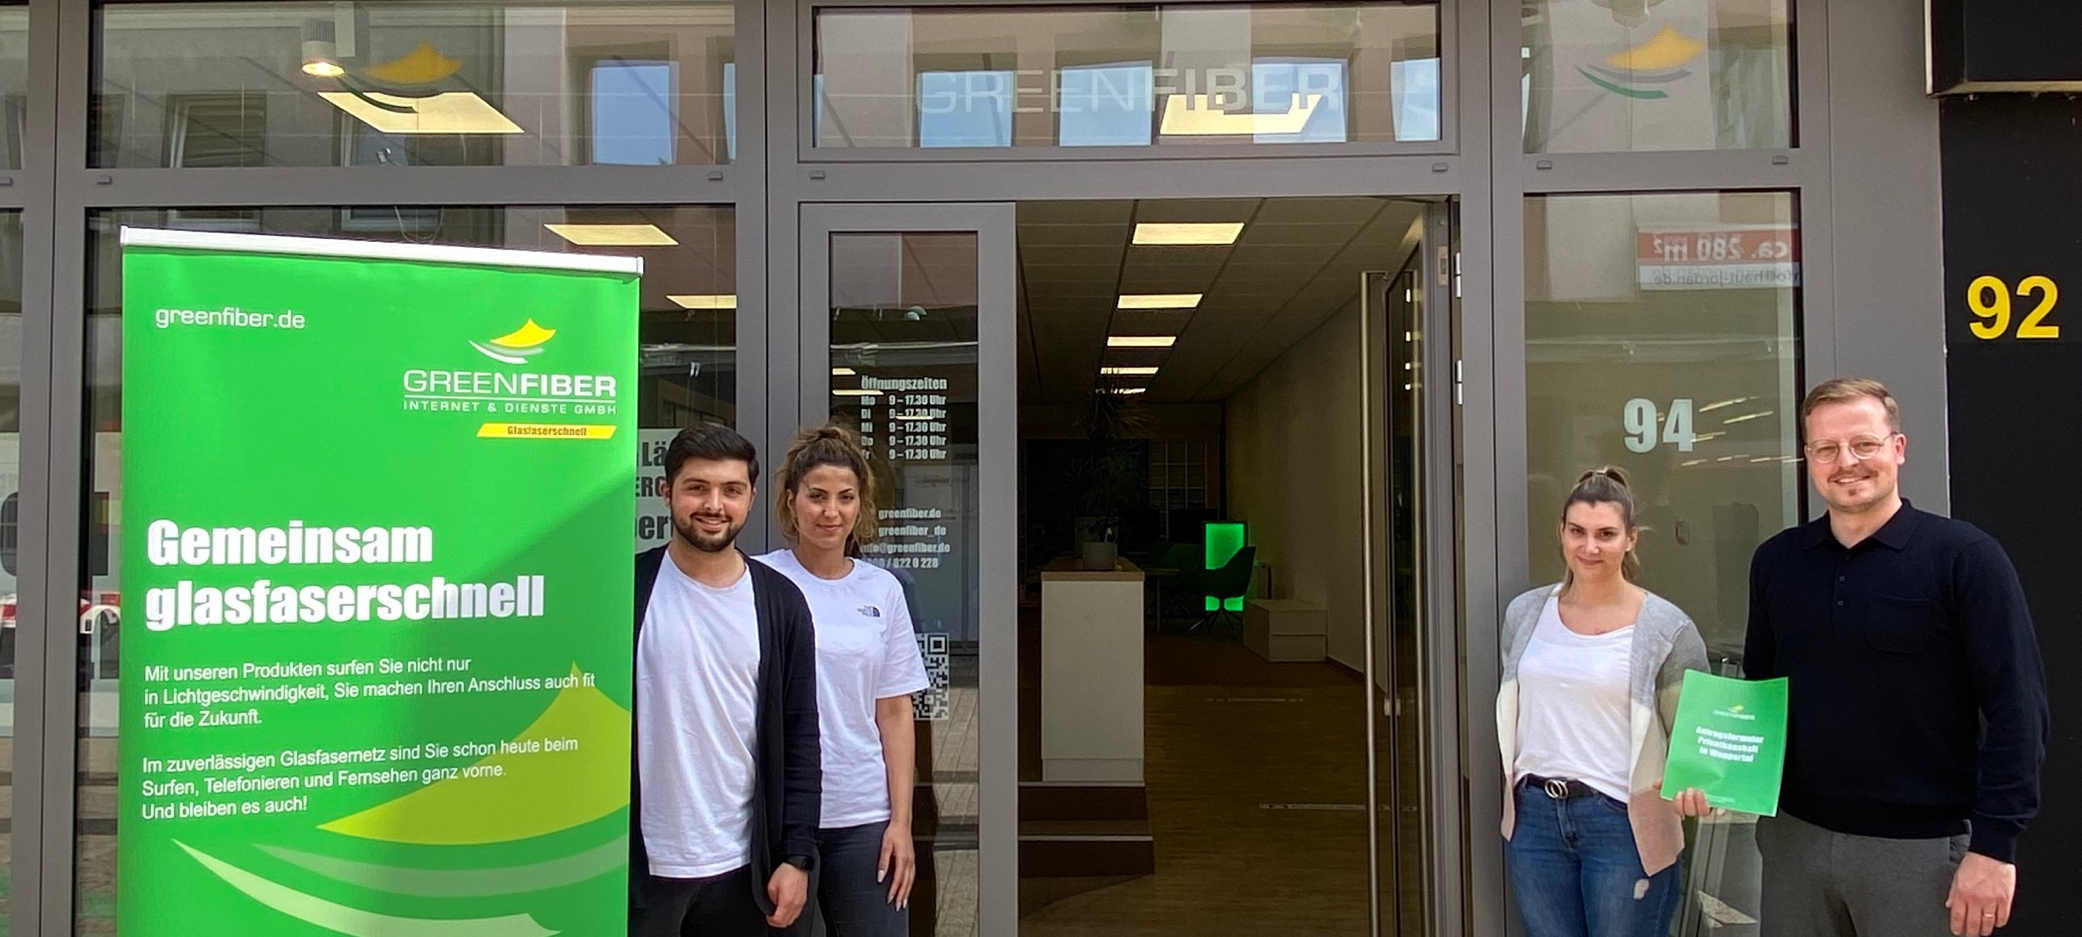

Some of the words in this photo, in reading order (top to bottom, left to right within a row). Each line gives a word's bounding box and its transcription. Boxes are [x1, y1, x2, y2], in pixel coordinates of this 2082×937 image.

[917, 68, 1340, 113] GREENFIBER
[155, 306, 306, 329] greenfiber.de
[1967, 275, 2060, 340] 92
[403, 369, 617, 398] GREENFIBER
[861, 375, 948, 391] Öffnungszeiten
[403, 400, 480, 412] INTERNET
[487, 402, 497, 413] &
[504, 402, 568, 415] DIENSTE
[574, 404, 617, 416] GMBH
[888, 394, 896, 405] 9
[905, 394, 928, 405] 17.30
[930, 394, 946, 405] Uhr
[888, 408, 896, 419] 9
[930, 408, 946, 419] Uhr
[1623, 398, 1696, 453] 94
[507, 425, 587, 437] Glasfaserschnell
[888, 422, 896, 433] 9
[905, 422, 928, 433] 17.30
[930, 422, 946, 433] Uhr
[888, 435, 896, 446] 9
[905, 435, 928, 446] 17.30
[930, 435, 946, 446] Uhr
[888, 449, 896, 460] 9
[905, 449, 928, 460] 17.30
[930, 449, 946, 460] Uhr
[147, 519, 433, 566] Gemeinsam
[146, 575, 544, 631] glasfaserschnell
[145, 665, 169, 681] Mit
[173, 665, 238, 681] unseren
[243, 662, 322, 679] Produkten
[327, 659, 374, 675] surfen
[379, 658, 403, 674] Sie
[407, 657, 443, 672] nicht
[447, 658, 471, 671] nur
[144, 689, 158, 705] in
[163, 684, 329, 707] Lichtgeschwindigkeit,
[334, 682, 359, 698] Sie
[363, 680, 422, 697] machen
[427, 679, 464, 694] Ihren
[468, 675, 540, 692] Anschluss
[545, 674, 578, 688] auch
[583, 672, 595, 688] fit
[144, 711, 166, 729] für
[169, 711, 194, 727] die
[198, 708, 262, 727] Zukunft.
[143, 757, 162, 773] Im
[167, 752, 275, 772] zuverlässigen
[280, 747, 385, 767] Glasfasernetz
[390, 745, 420, 761] sind
[425, 743, 448, 759] Sie
[453, 742, 496, 757] schon
[501, 739, 540, 755] heute
[544, 737, 578, 752] beim
[142, 779, 199, 797] Surfen,
[204, 775, 299, 793] Telefonieren
[304, 772, 333, 788] und
[338, 768, 417, 786] Fernsehen
[422, 767, 458, 785] ganz
[462, 765, 507, 778] vorne.
[142, 803, 174, 820] Und
[179, 800, 237, 818] bleiben
[241, 802, 260, 815] es
[265, 795, 308, 813] auch!
